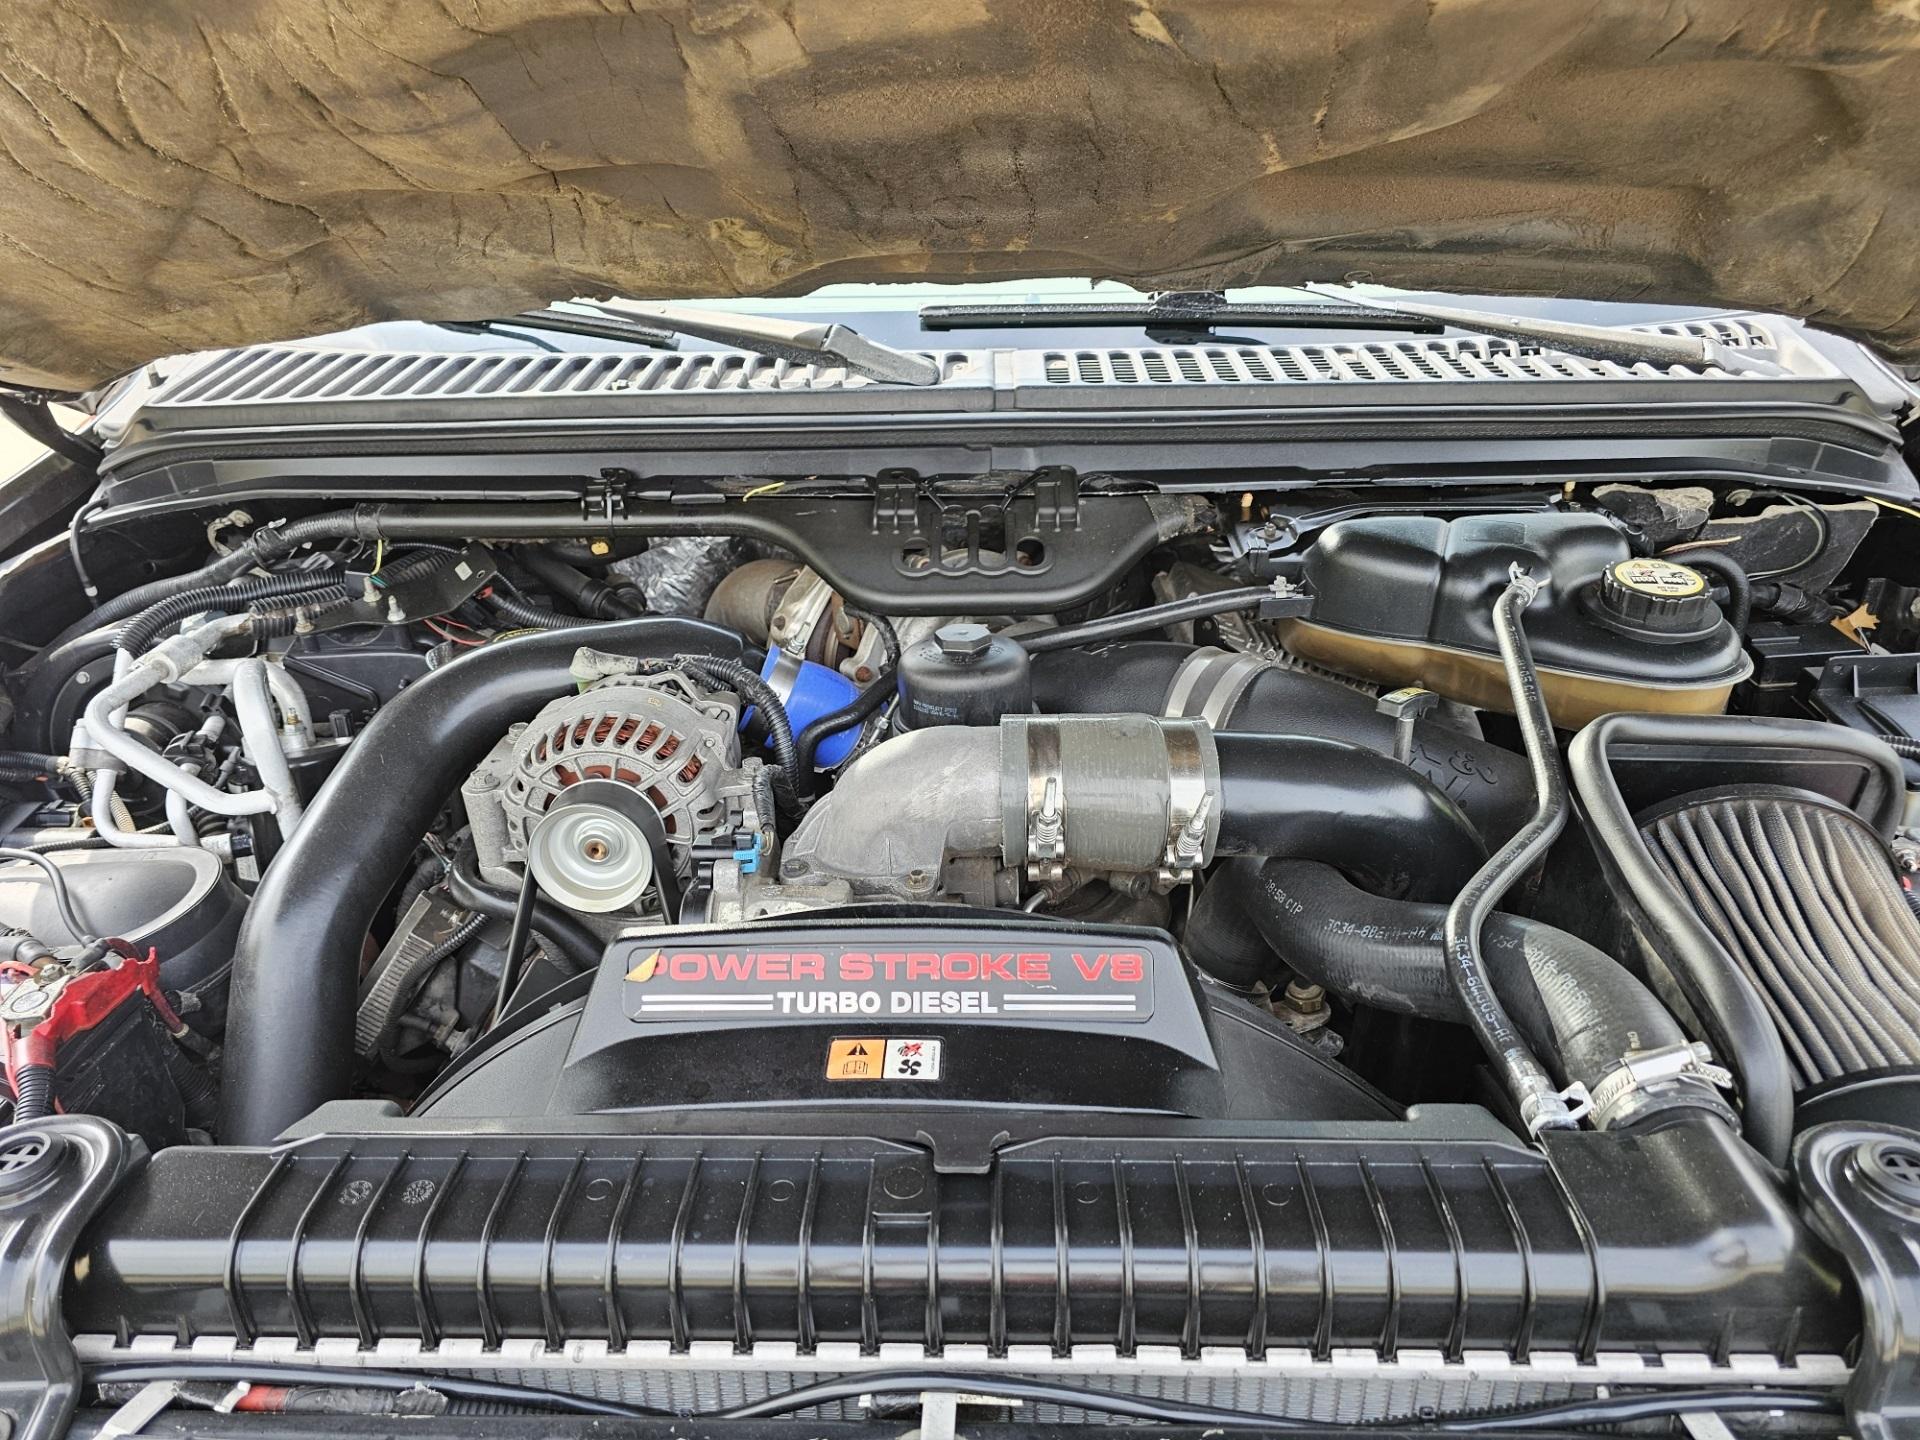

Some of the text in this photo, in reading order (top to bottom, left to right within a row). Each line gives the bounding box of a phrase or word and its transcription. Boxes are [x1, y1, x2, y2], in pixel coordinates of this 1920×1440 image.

[1285, 898, 1303, 915] CIP
[839, 952, 1051, 982] STROKE
[1071, 953, 1144, 983] V8
[777, 991, 998, 1014] TURBO DIESEL
